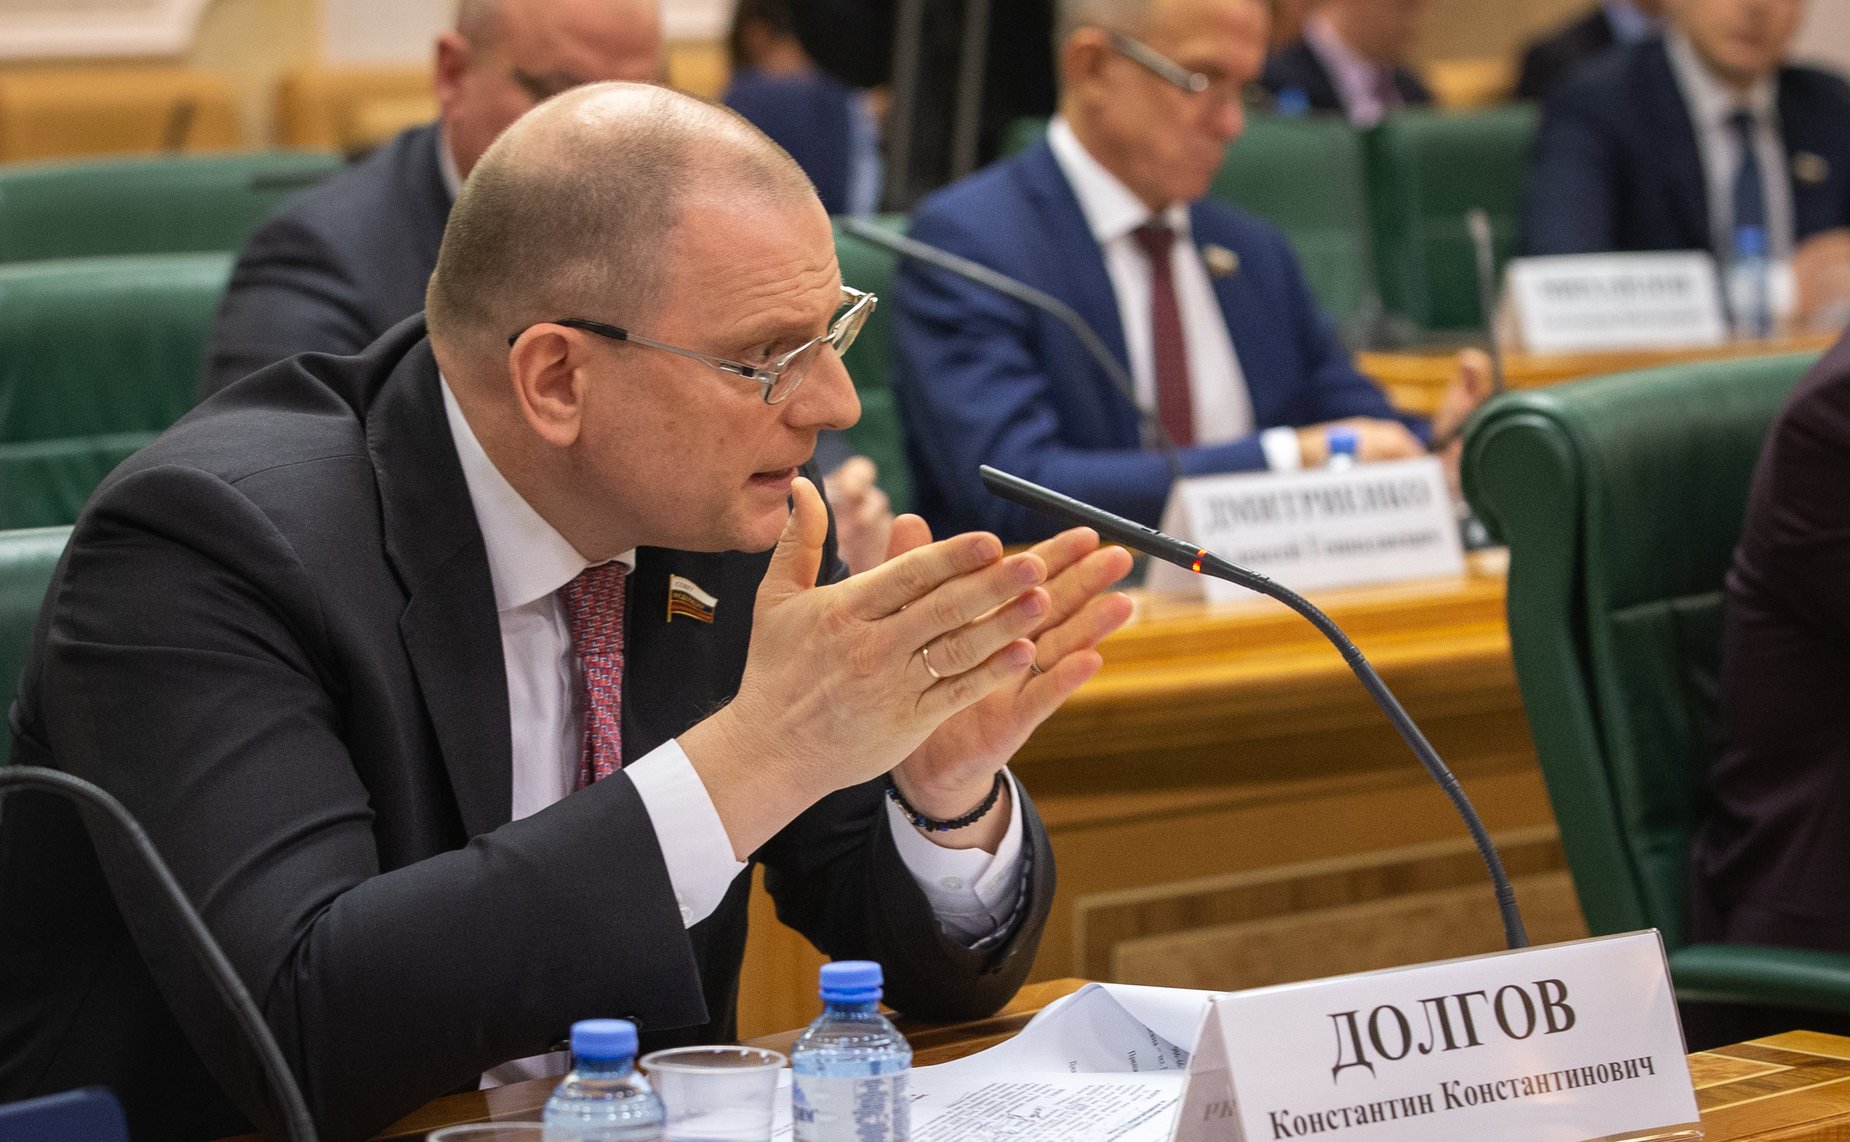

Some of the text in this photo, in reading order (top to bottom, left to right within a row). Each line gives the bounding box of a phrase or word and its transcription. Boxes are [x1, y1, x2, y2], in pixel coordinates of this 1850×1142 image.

[1327, 978, 1576, 1085] ДОЛГОВ
[1268, 1055, 1656, 1141] Константин Константинович
